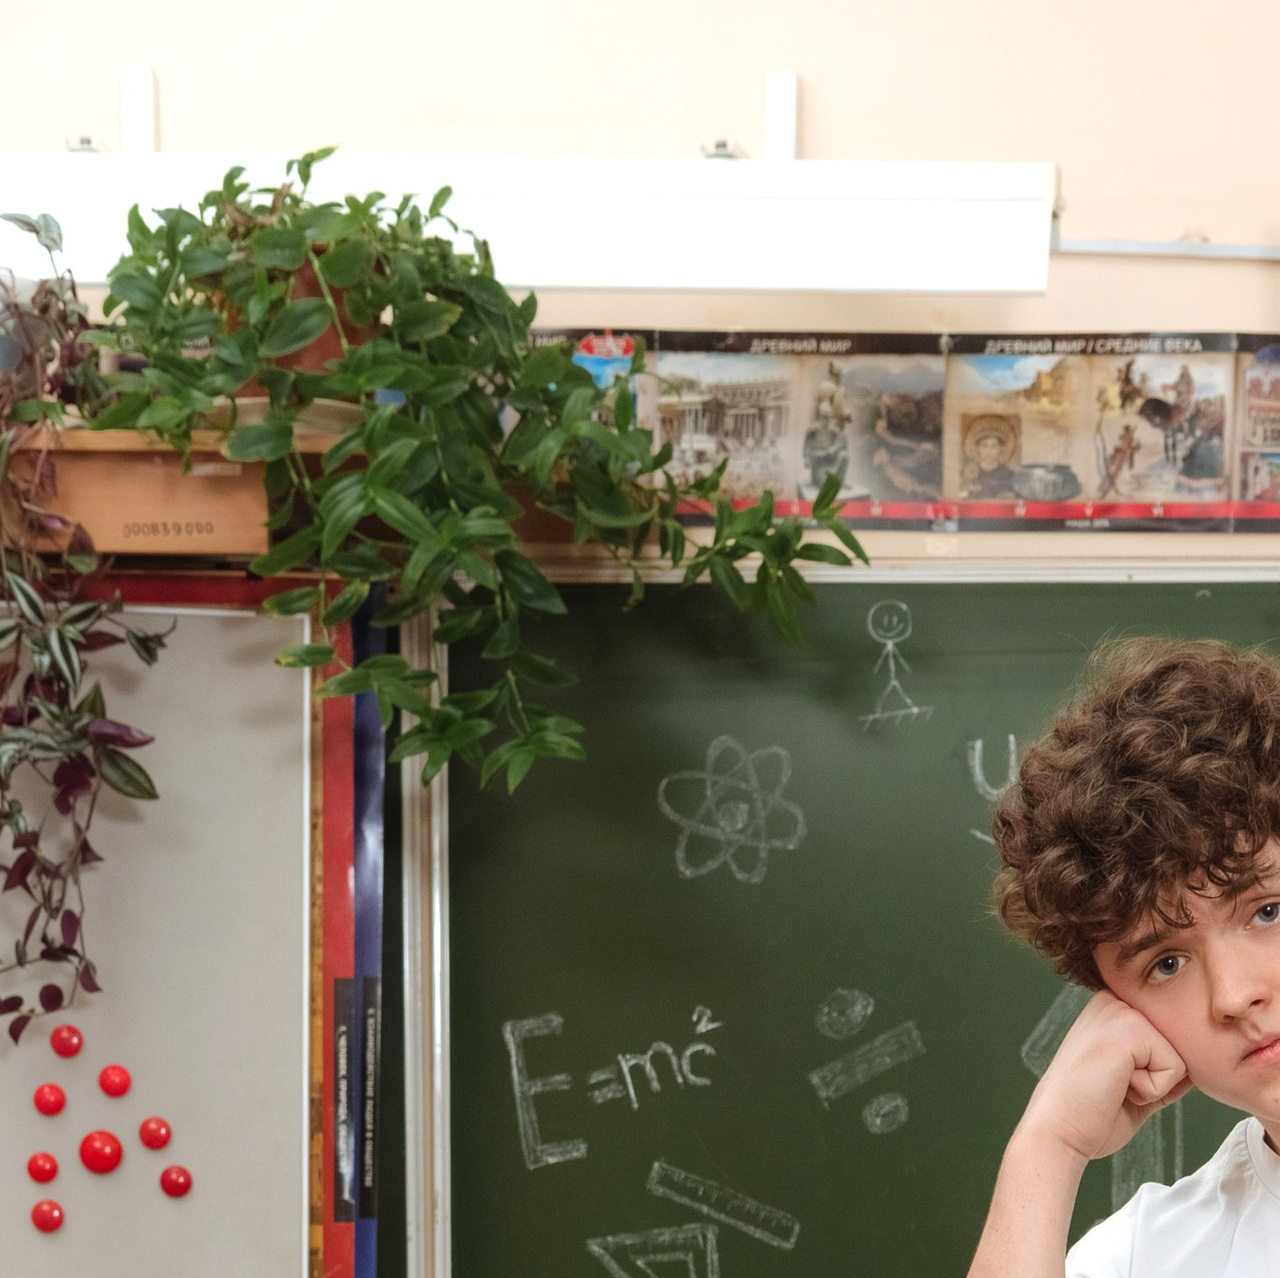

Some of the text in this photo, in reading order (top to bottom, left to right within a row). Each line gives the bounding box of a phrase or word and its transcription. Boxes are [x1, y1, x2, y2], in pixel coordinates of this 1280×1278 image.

[751, 337, 852, 354] ДРЕВНИЙ МИР
[984, 339, 1051, 355] ДРЕВНИЙ
[1055, 340, 1086, 354] МИР
[1096, 340, 1161, 354] СРЕДНИЕ
[1164, 338, 1203, 352] ВЕКА
